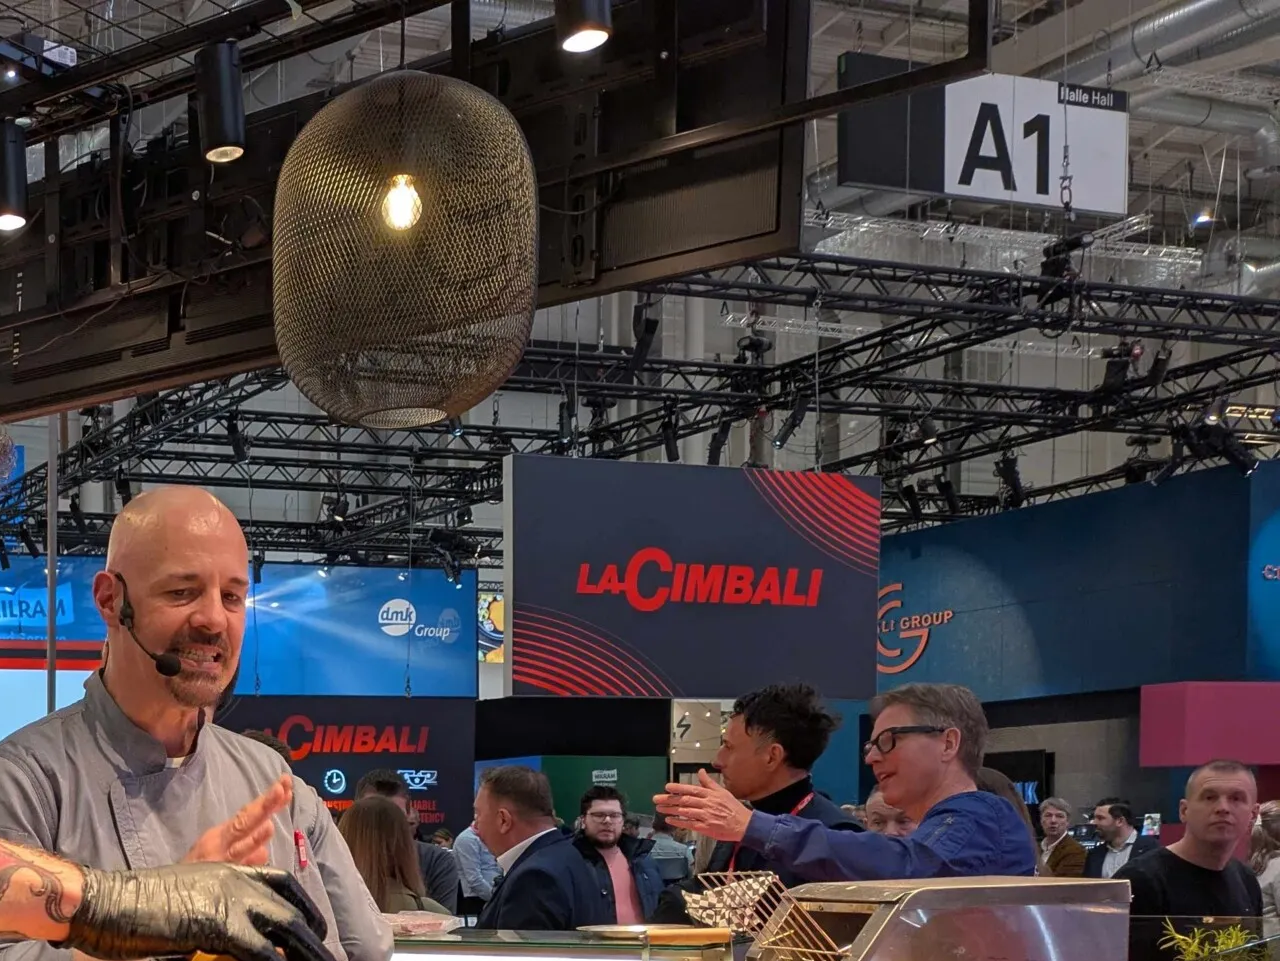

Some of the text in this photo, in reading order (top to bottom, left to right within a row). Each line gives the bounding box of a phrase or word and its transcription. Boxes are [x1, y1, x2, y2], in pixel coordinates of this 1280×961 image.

[1060, 86, 1114, 107] Halle Hall
[957, 102, 1051, 196] A1
[380, 607, 451, 641] dmk Group
[900, 610, 953, 630] GROUP
[244, 714, 430, 761] CIMBALI
